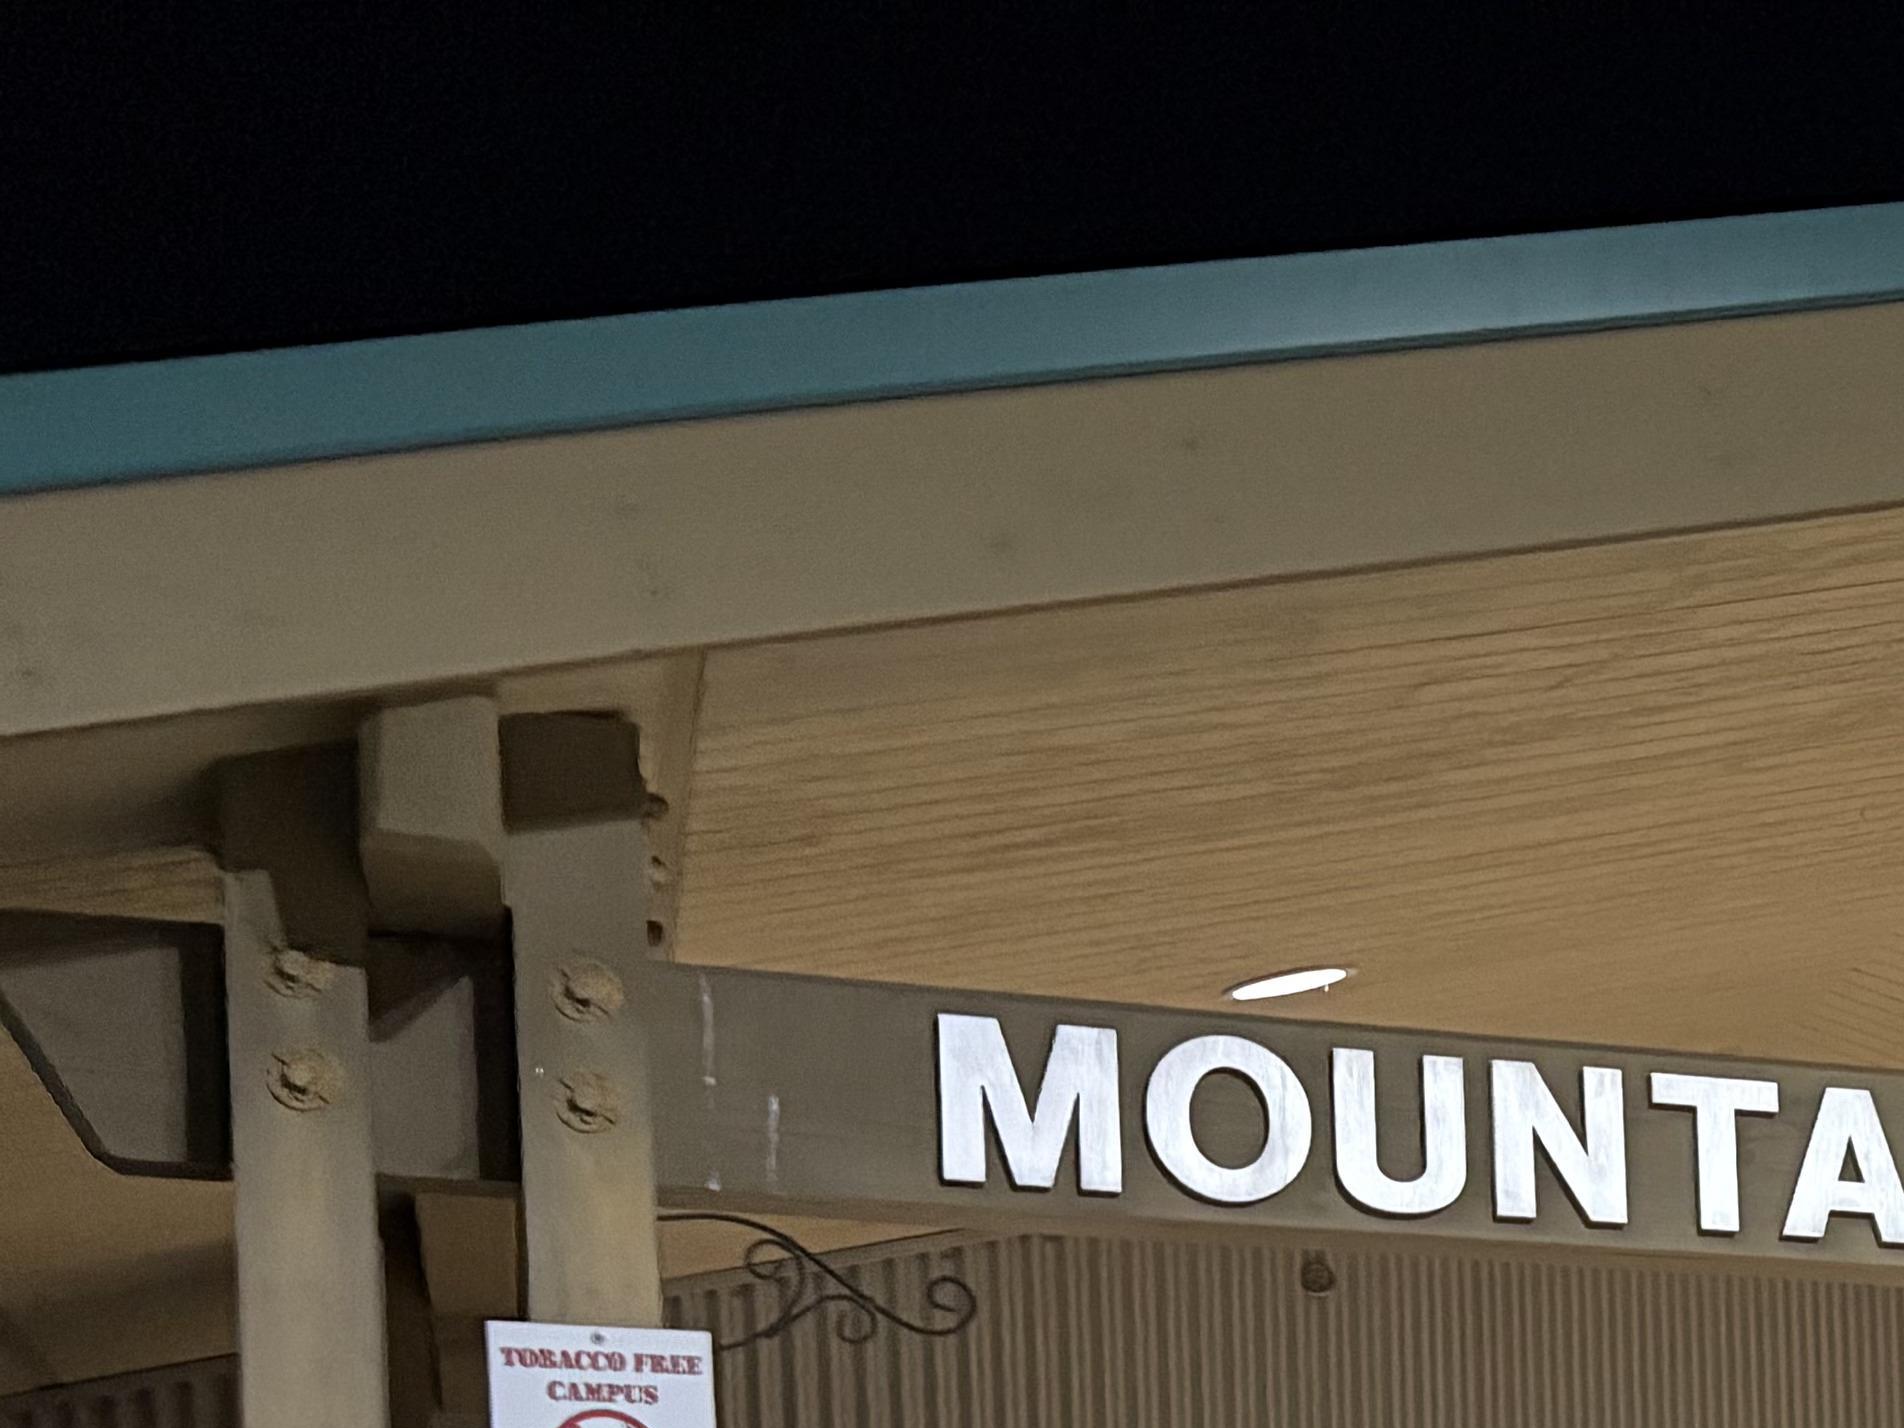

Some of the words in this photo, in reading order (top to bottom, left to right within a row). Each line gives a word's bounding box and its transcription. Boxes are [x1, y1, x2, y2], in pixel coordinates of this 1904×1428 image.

[499, 1346, 627, 1371] TOBACCO
[633, 1353, 704, 1375] FREE
[546, 1380, 659, 1405] CAMPUS
